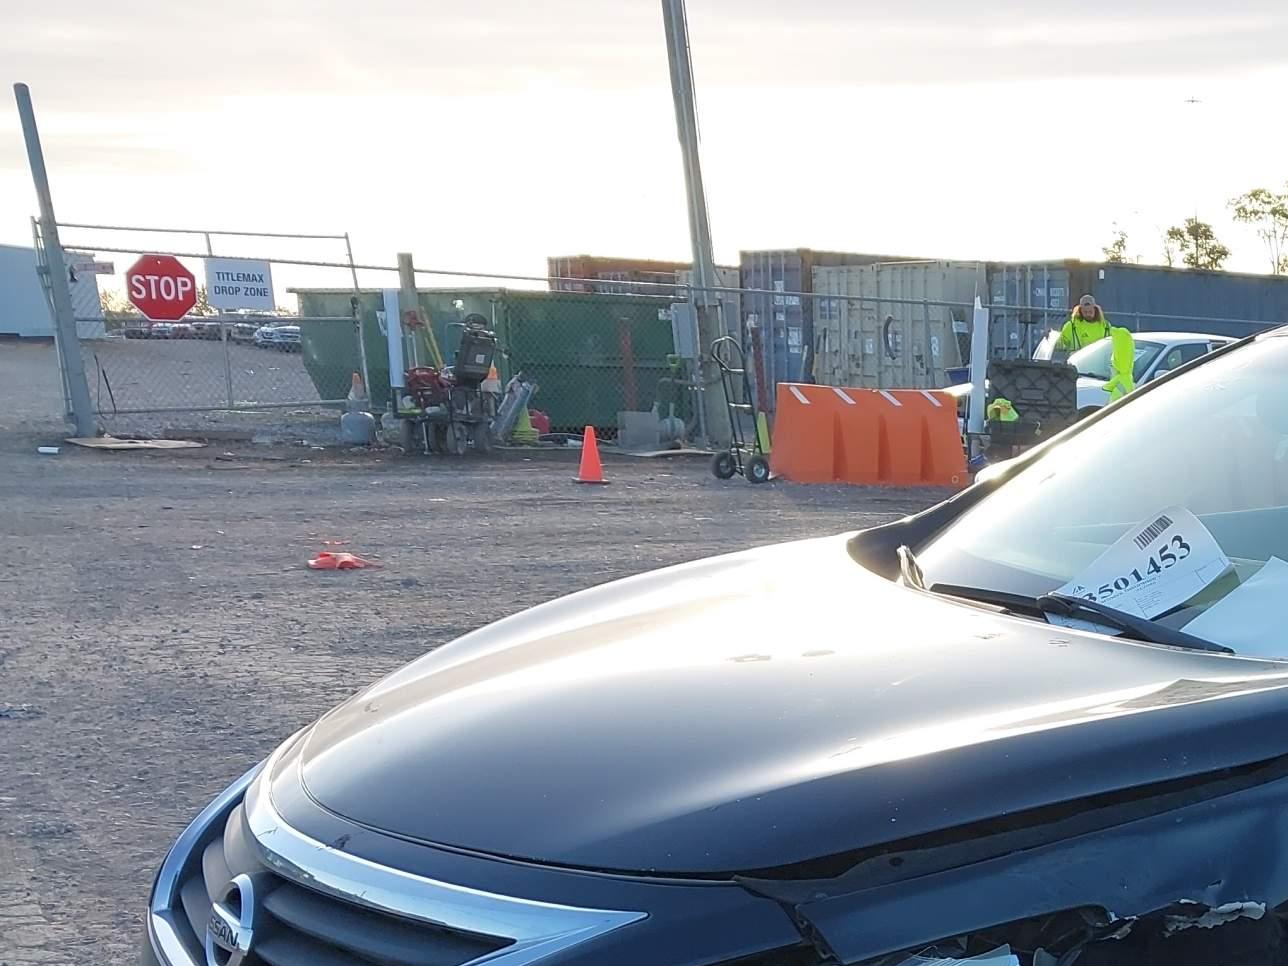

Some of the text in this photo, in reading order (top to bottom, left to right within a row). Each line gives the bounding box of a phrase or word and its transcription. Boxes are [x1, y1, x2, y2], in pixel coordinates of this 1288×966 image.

[131, 274, 192, 300] STOP
[215, 271, 264, 284] TITLEMAX
[213, 285, 269, 297] DROP ZONE
[1080, 534, 1191, 602] 3501453
